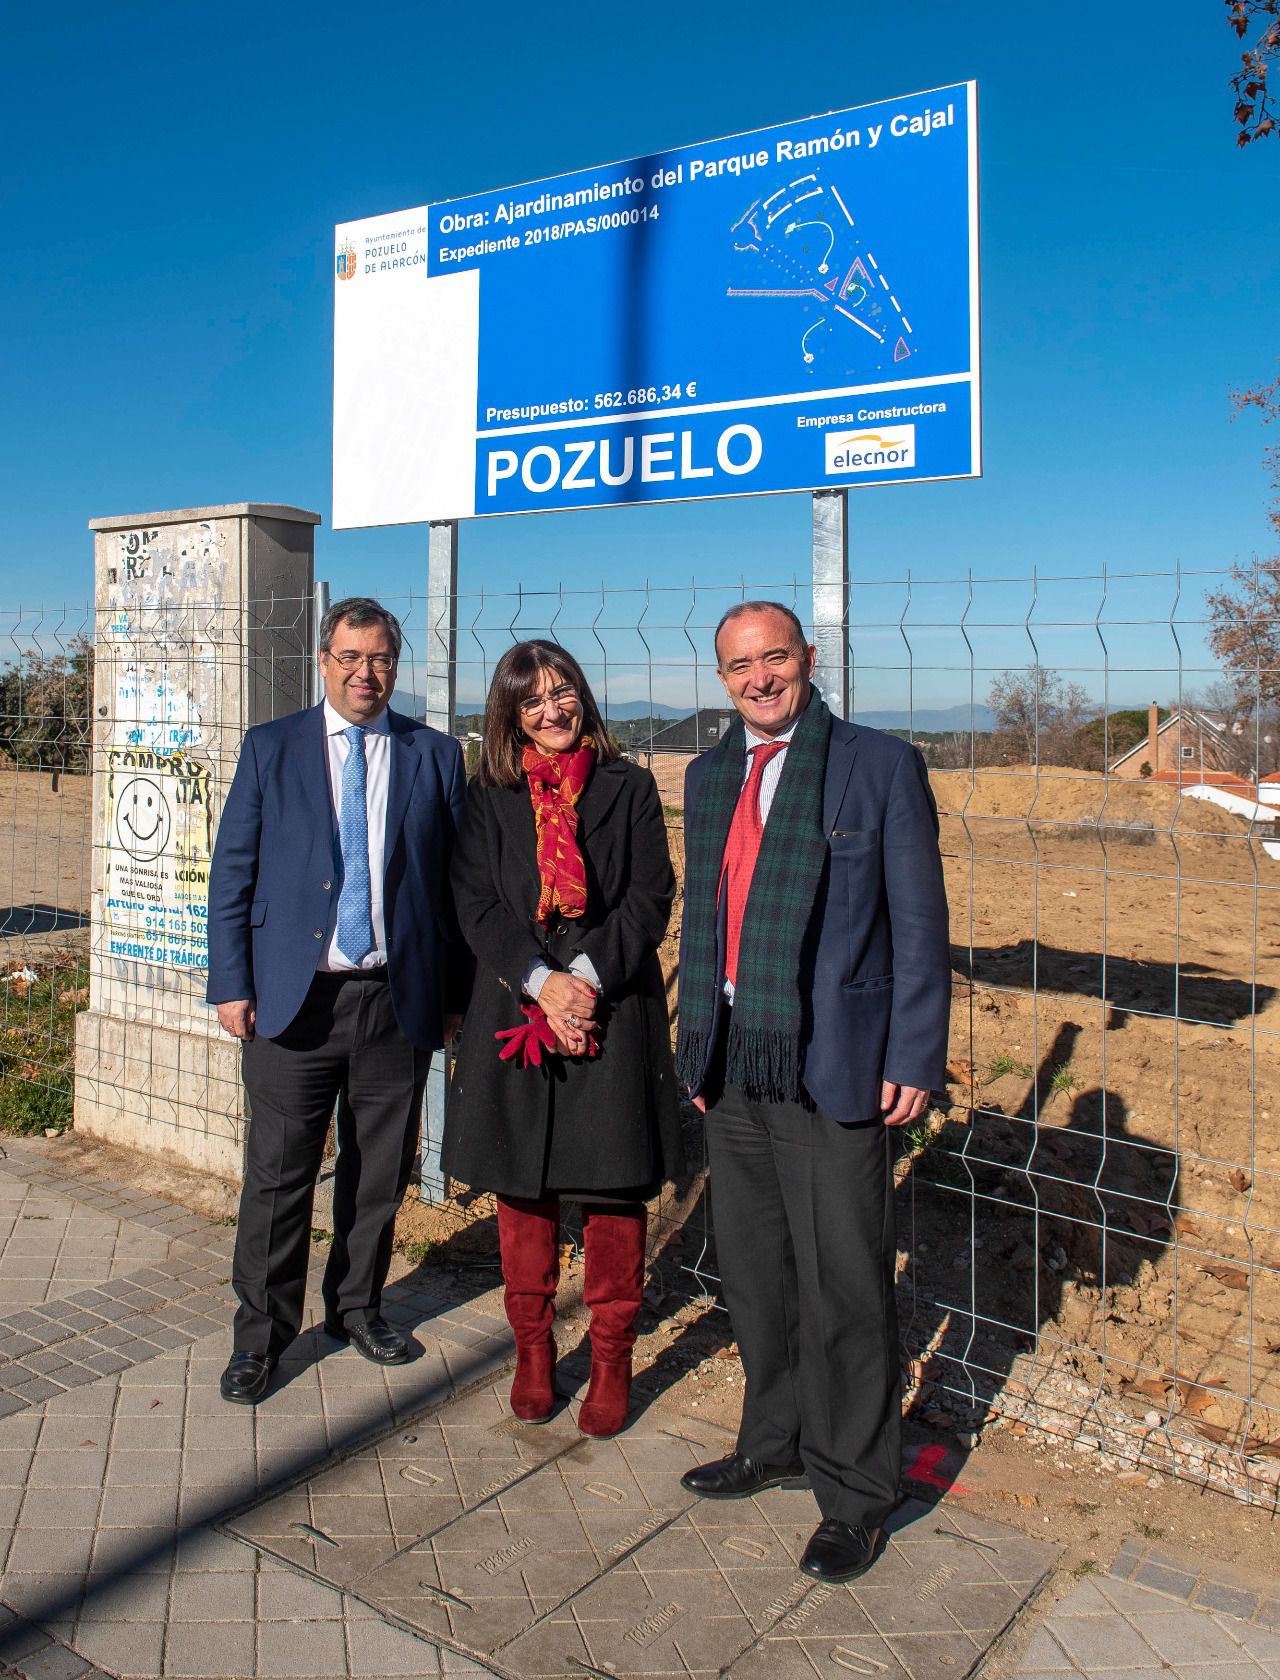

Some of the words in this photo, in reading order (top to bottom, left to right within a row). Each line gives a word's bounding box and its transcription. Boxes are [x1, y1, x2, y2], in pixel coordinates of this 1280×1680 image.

[439, 209, 490, 234] Obra:
[495, 176, 644, 225] Ajardinamiento
[651, 162, 683, 189] del
[690, 149, 769, 181] Parque
[777, 129, 861, 163] Ramón
[868, 124, 883, 149] y
[890, 104, 955, 137] Cajal
[365, 228, 415, 244] Ayuntamiento
[417, 225, 427, 234] de
[439, 233, 521, 263] Expediente
[524, 204, 660, 245] 2018/PAS/000014
[365, 242, 407, 259] POZUELO
[365, 263, 376, 274] DE
[380, 250, 426, 271] ALARCÓN
[486, 397, 590, 423] Presupuesto:
[593, 383, 682, 410] 562.686,34
[685, 381, 697, 398] €
[797, 412, 854, 429] Empresa
[857, 402, 947, 422] Constructora
[487, 423, 763, 497] POZUELO
[833, 448, 908, 469] elecnor
[115, 864, 129, 873] UNA
[130, 866, 158, 878] SONRISA
[160, 870, 169, 880] ES
[119, 876, 133, 886] MAS
[135, 879, 163, 891] VALIOSA
[121, 889, 136, 899] QUE
[136, 891, 145, 900] EL
[146, 893, 160, 902] ORO
[186, 903, 209, 919] 162
[145, 916, 165, 929] 914
[168, 918, 187, 931] 165
[110, 940, 154, 960] ENFRENTE
[156, 947, 168, 961] DE
[170, 948, 209, 967] TRÁFICO
